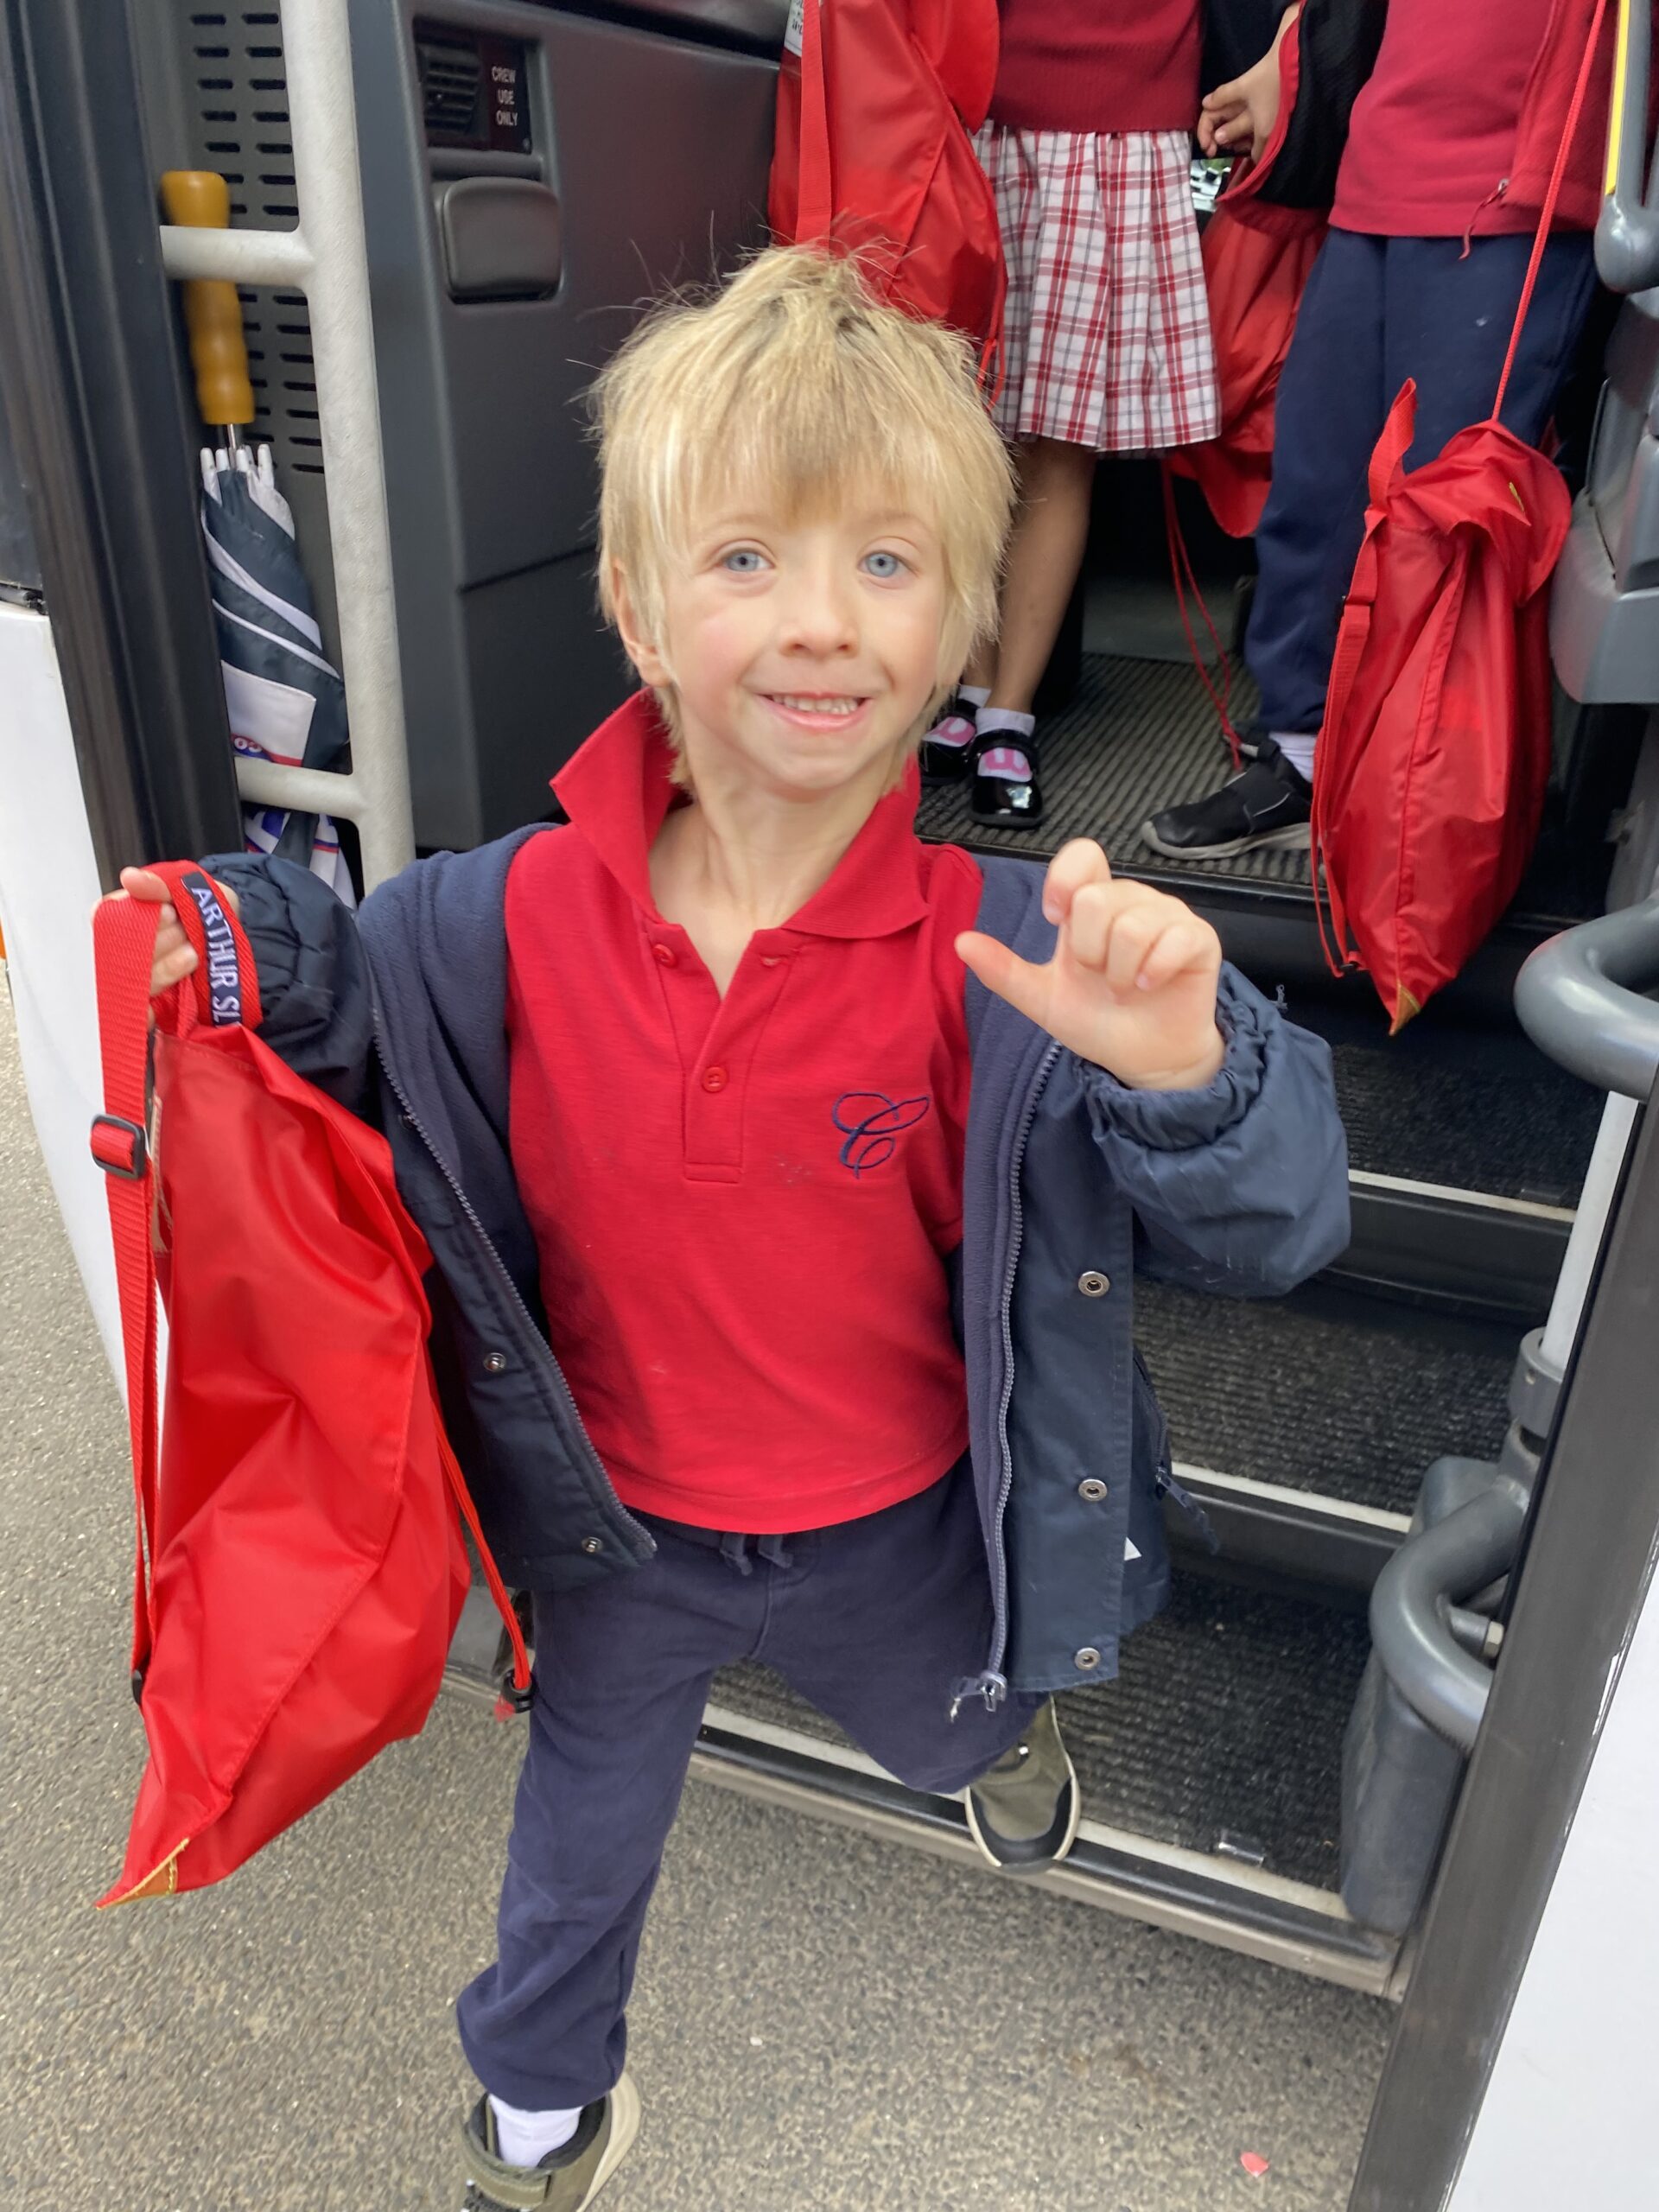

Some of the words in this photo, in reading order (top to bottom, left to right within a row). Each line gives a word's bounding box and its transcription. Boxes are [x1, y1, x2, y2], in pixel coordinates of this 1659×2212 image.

[492, 66, 517, 83] CREW
[497, 89, 515, 105] USE
[496, 110, 518, 126] ONLY
[191, 887, 239, 989] ARTHUR
